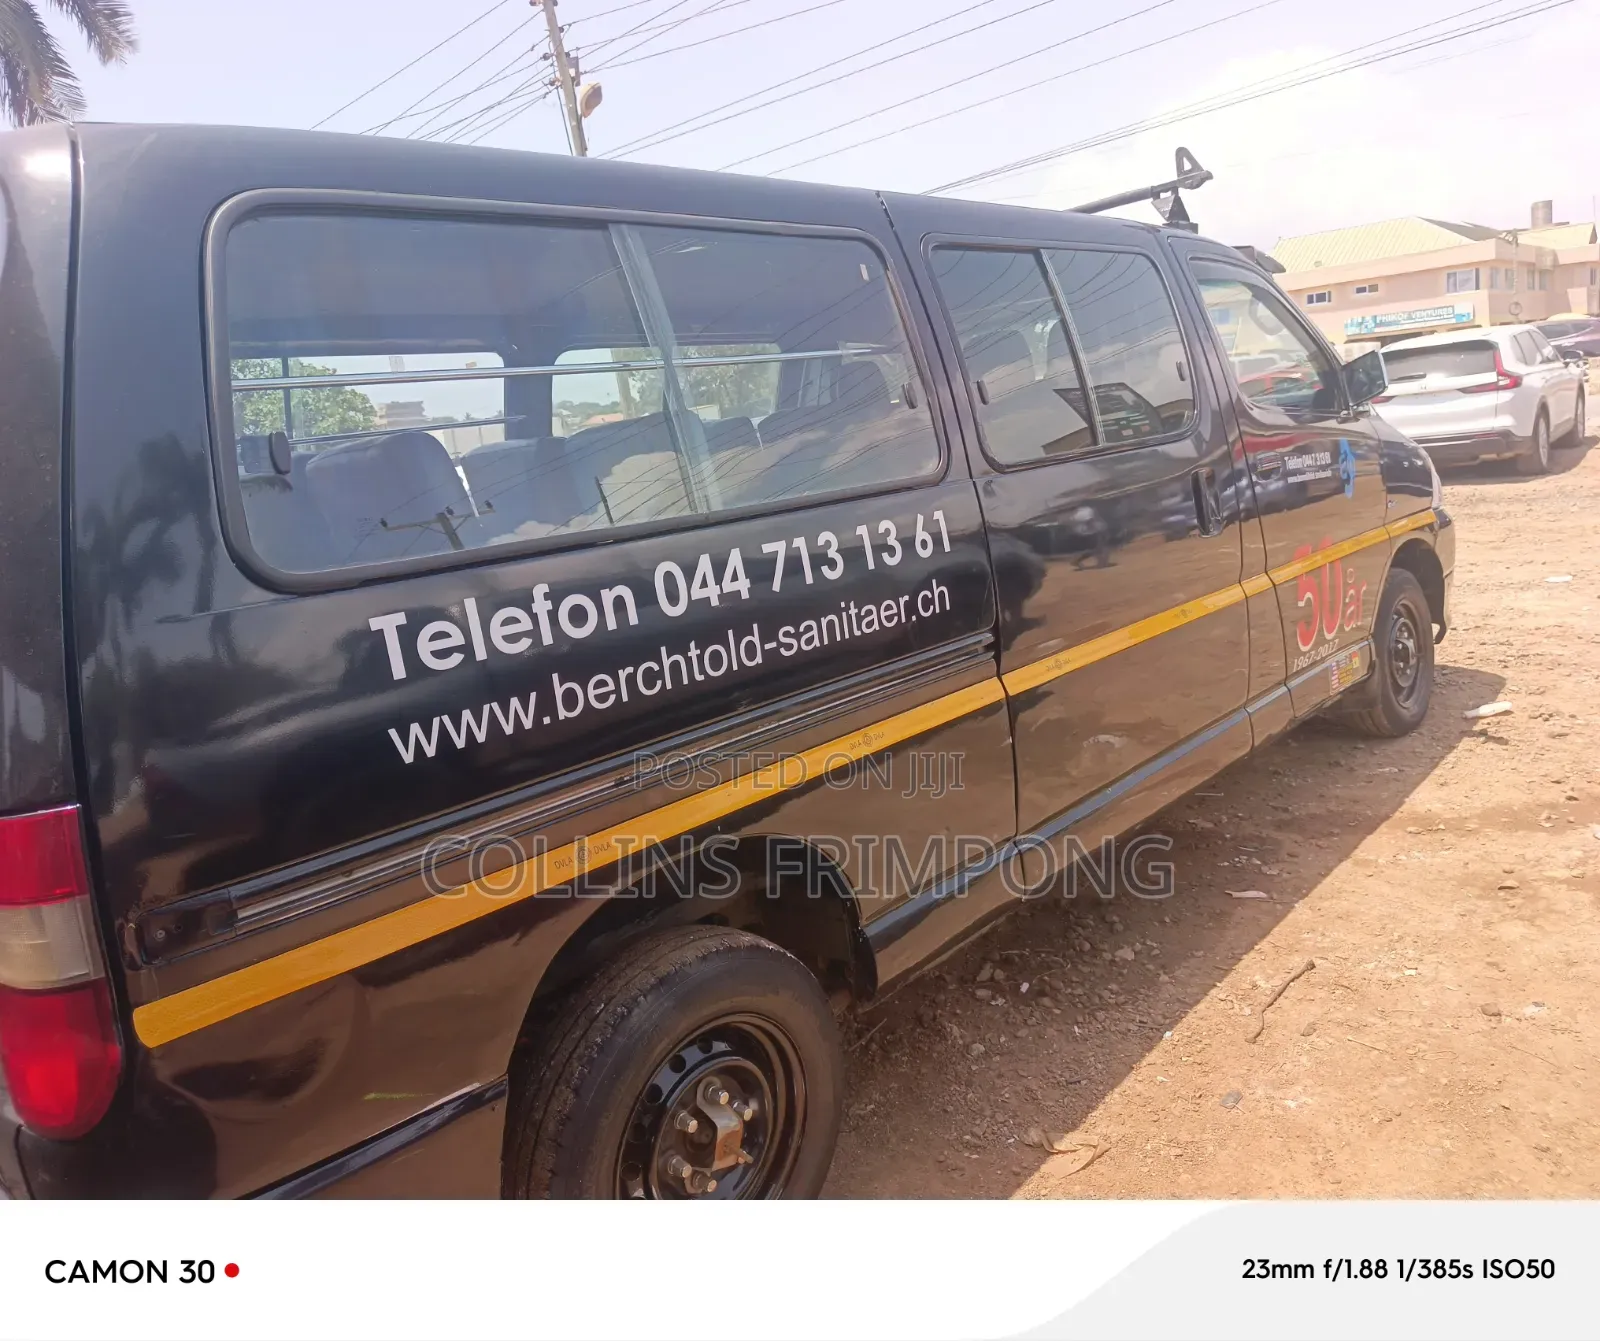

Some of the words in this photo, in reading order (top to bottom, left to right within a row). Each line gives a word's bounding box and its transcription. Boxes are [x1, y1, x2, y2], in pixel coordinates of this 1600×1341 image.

[1410, 306, 1453, 319] VENTURES
[369, 583, 639, 681] Telefon
[654, 547, 751, 618] 044
[761, 530, 844, 592] 713
[855, 520, 903, 571] 13
[915, 509, 952, 559] 61
[1293, 535, 1343, 652] 50
[387, 579, 952, 765] www.berchtold-sanitaer.ch
[1293, 638, 1340, 673] 1967-2017
[553, 856, 574, 870] DVLA
[593, 841, 612, 855] DVLA
